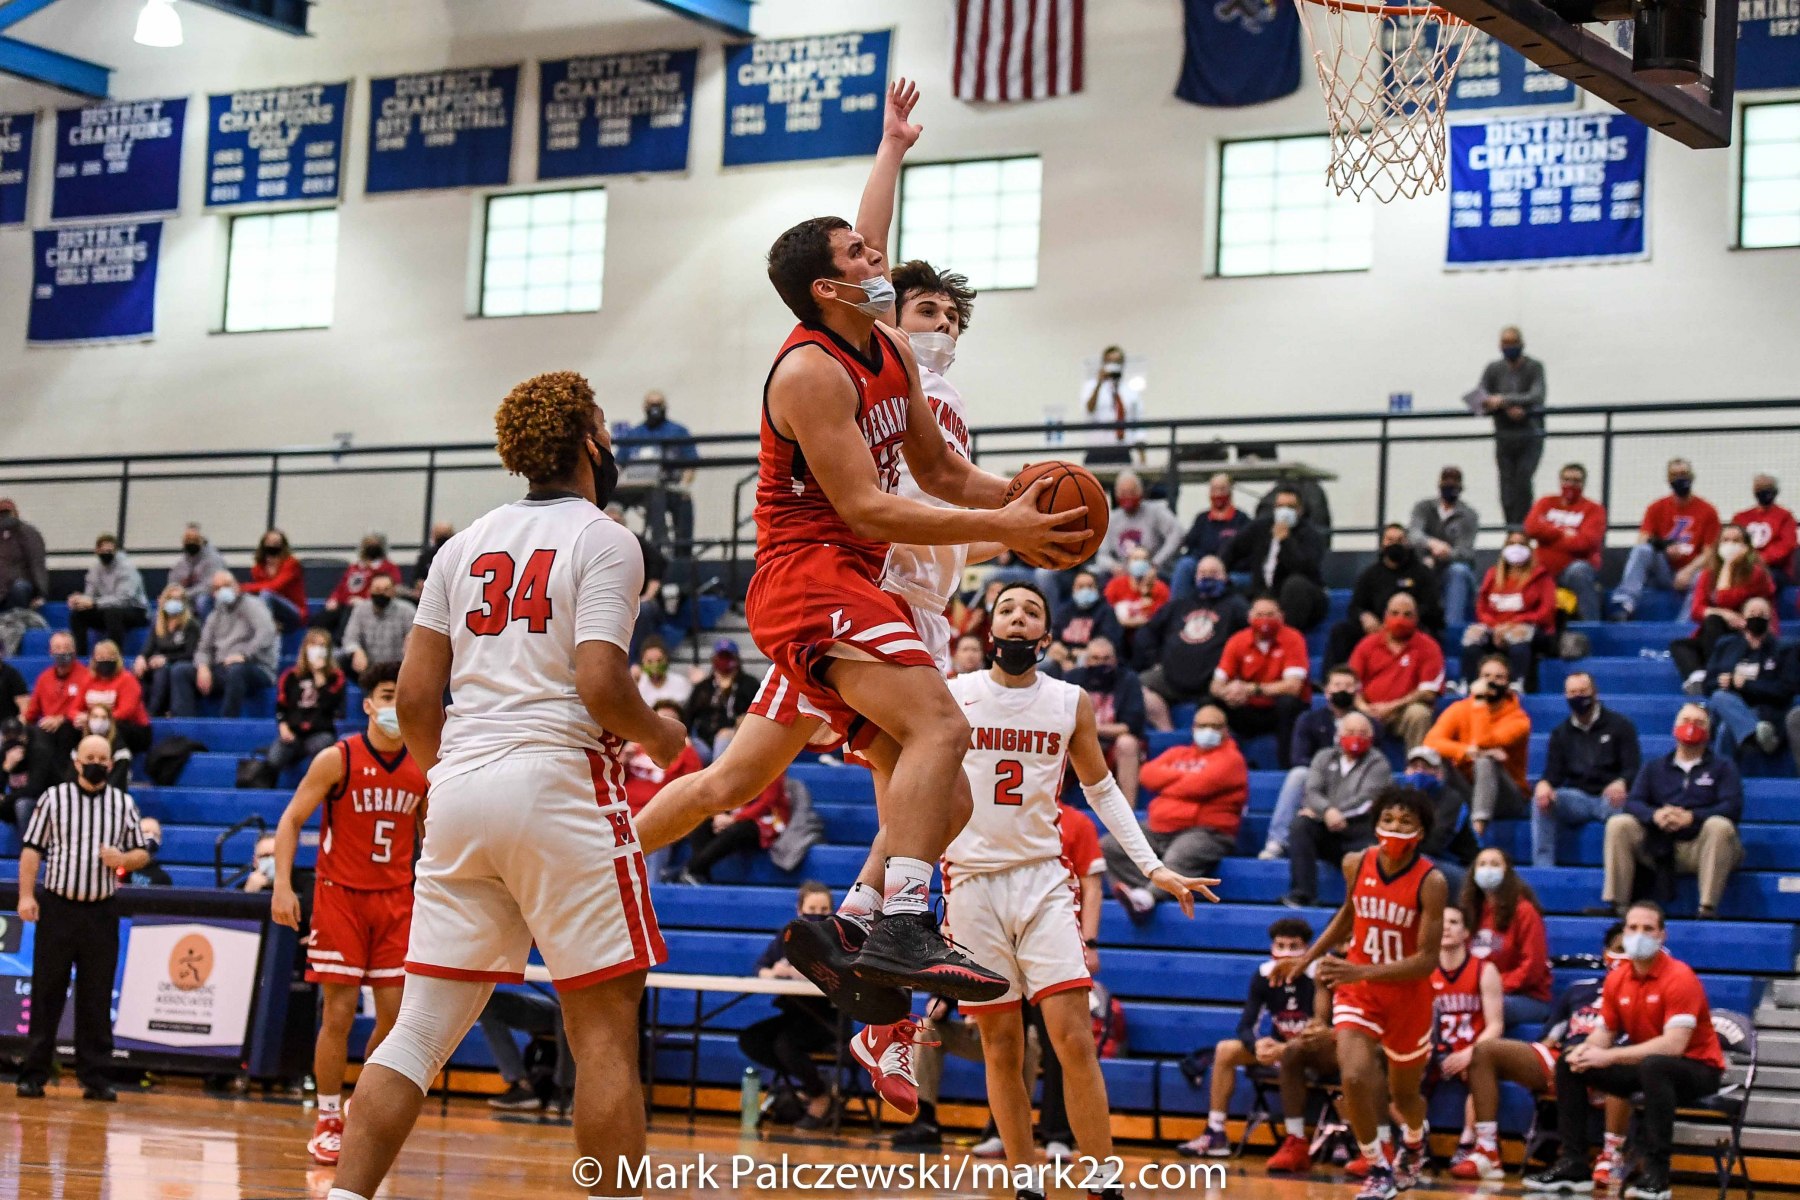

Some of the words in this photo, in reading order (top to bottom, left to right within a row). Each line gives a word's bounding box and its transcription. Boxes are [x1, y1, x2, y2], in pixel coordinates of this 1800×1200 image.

[752, 34, 863, 63] DISTRICT
[568, 53, 670, 80] DISTRICT
[738, 52, 876, 86] CHAMPIONS
[396, 70, 491, 98] DISTRICT
[554, 71, 681, 99] CHAMPIONS
[768, 78, 842, 104] RIFLE
[232, 87, 324, 113] DISTRICT
[382, 87, 504, 119] CHAMPIONS
[81, 102, 163, 128] DISTRICT
[219, 103, 334, 133] CHAMPIONS
[69, 117, 173, 146] CHAMPIONS
[248, 126, 300, 149] GOLF
[1486, 116, 1612, 144] DISTRICT
[1469, 136, 1628, 170] CHAMPIONS
[58, 225, 137, 249] DISTRICT
[46, 241, 148, 268] CHAMPIONS
[862, 396, 909, 449] LEBANO
[465, 548, 557, 637] 34
[994, 758, 1024, 807] 2
[371, 820, 396, 864] 5
[1352, 895, 1417, 929] LEBANON
[1363, 926, 1404, 965] 40
[1440, 1012, 1475, 1044] 24
